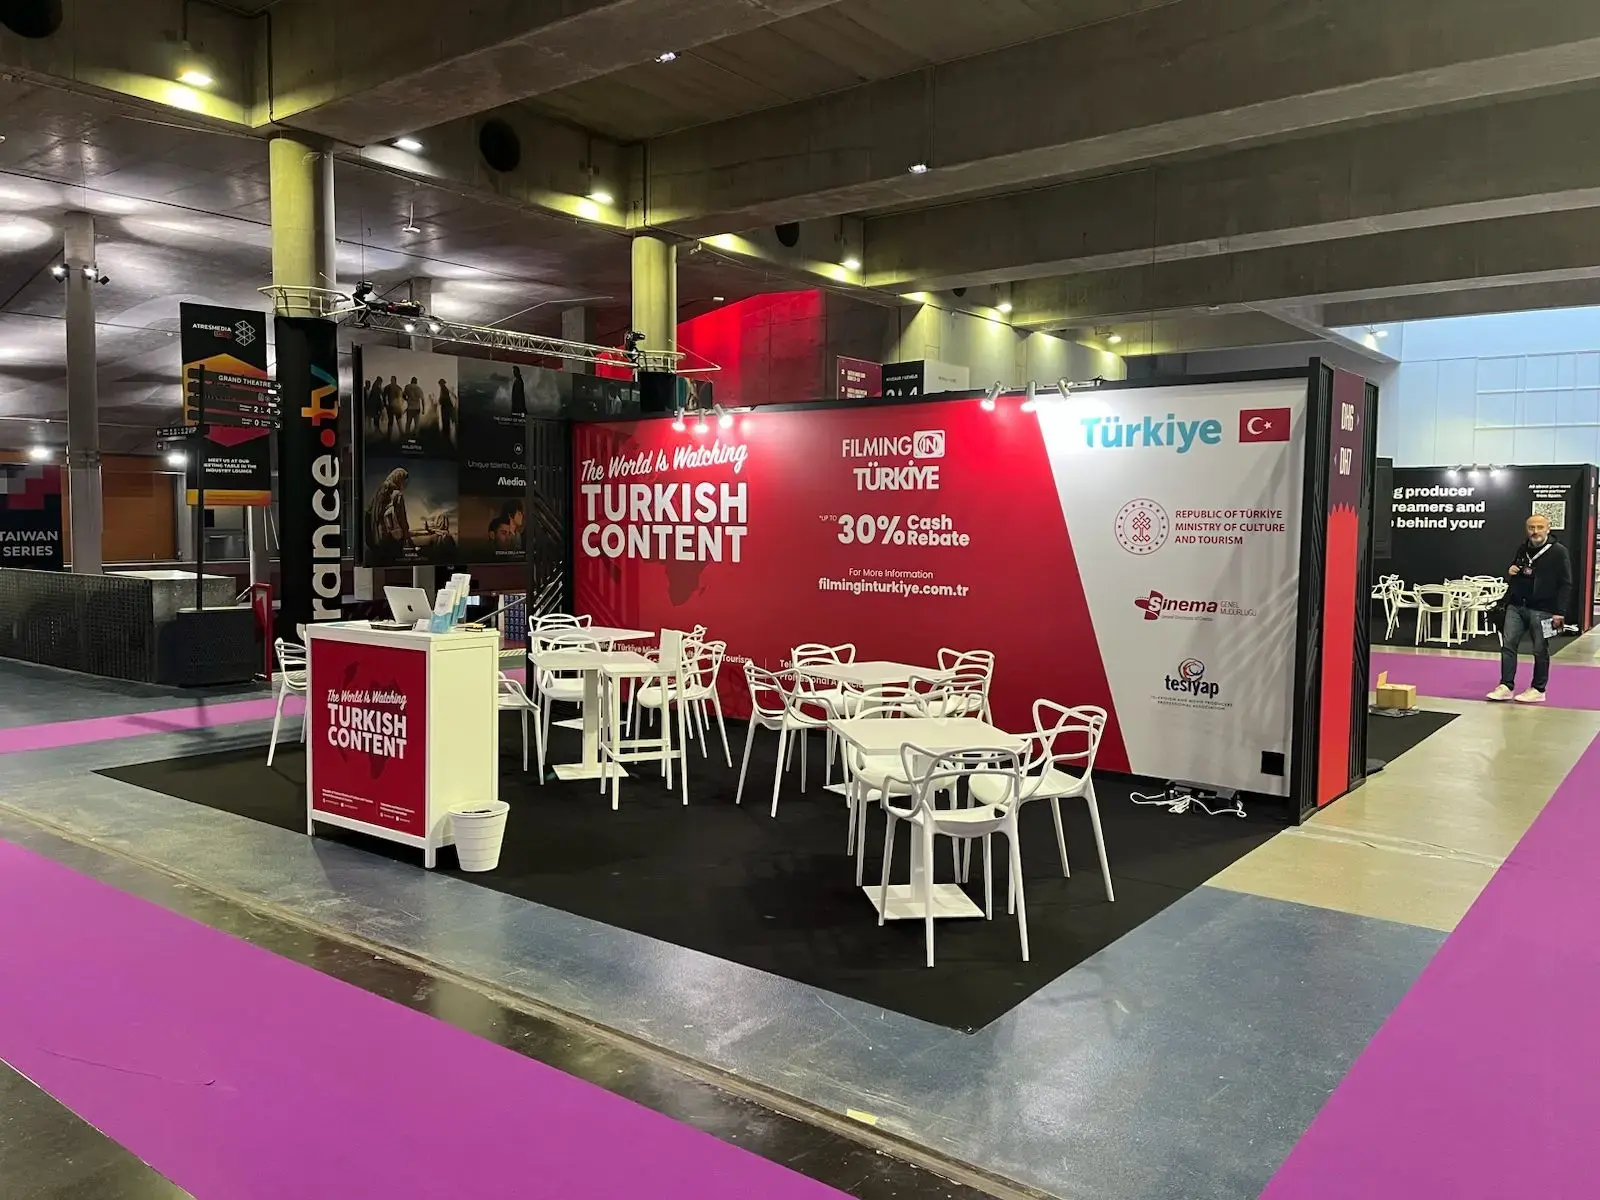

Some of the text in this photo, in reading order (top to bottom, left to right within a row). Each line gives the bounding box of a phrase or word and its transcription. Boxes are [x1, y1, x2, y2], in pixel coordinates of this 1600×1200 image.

[192, 323, 232, 332] ATRESMEDIA
[218, 374, 272, 388] GRAND THEATRE
[1341, 402, 1355, 432] DH6
[1080, 413, 1222, 454] Türkiye
[842, 435, 913, 458] FILMING
[581, 438, 748, 482] The World Is Watching
[853, 459, 940, 491] TÜRKİYE
[297, 362, 342, 638] rance.tv
[581, 481, 748, 524] TURKISH
[1405, 485, 1475, 499] producer
[1175, 507, 1283, 519] REPUBLIC OF TÜRKİYE
[1391, 500, 1486, 513] reamers and
[837, 514, 906, 545] 30%
[907, 514, 953, 531] Cash
[1175, 522, 1286, 532] MINISTRY OF CULTURE
[1396, 516, 1448, 529] behind
[1449, 519, 1486, 531] your
[0, 530, 59, 541] TAIWAN
[581, 523, 748, 563] CONTENT
[907, 530, 971, 547] Rebate
[1175, 535, 1244, 545] AND TOURISM
[3, 545, 54, 557] SERIES
[849, 567, 934, 579] For More Information
[818, 577, 969, 598] filminginturkiye.com.tr
[1148, 595, 1218, 613] Sinema
[1164, 674, 1219, 699] tesiyap
[327, 688, 408, 711] The World Is Watching
[327, 703, 407, 739] TURKISH
[327, 726, 408, 760] CONTENT
